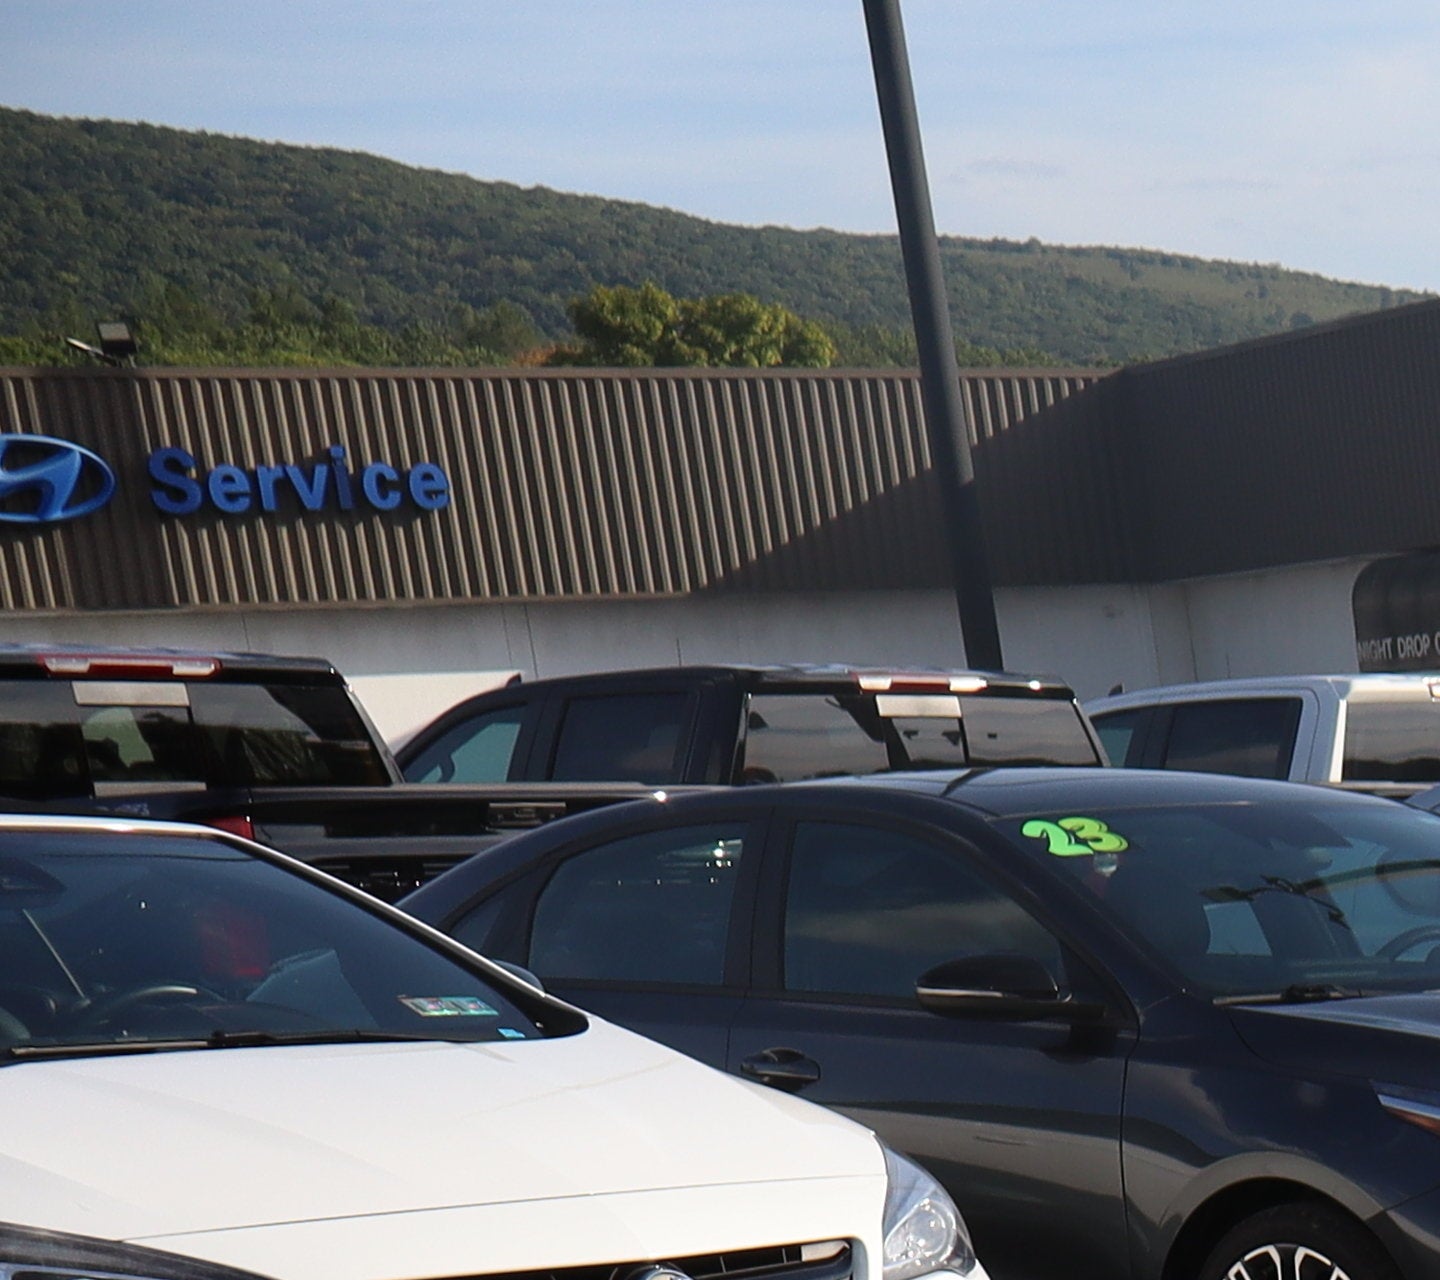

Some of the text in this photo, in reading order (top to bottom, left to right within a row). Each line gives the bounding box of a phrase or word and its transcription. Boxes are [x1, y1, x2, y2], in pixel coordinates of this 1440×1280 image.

[149, 445, 449, 516] Service
[1358, 638, 1394, 662] NIGHT
[1397, 634, 1431, 659] DROP
[1022, 816, 1128, 857] 23
